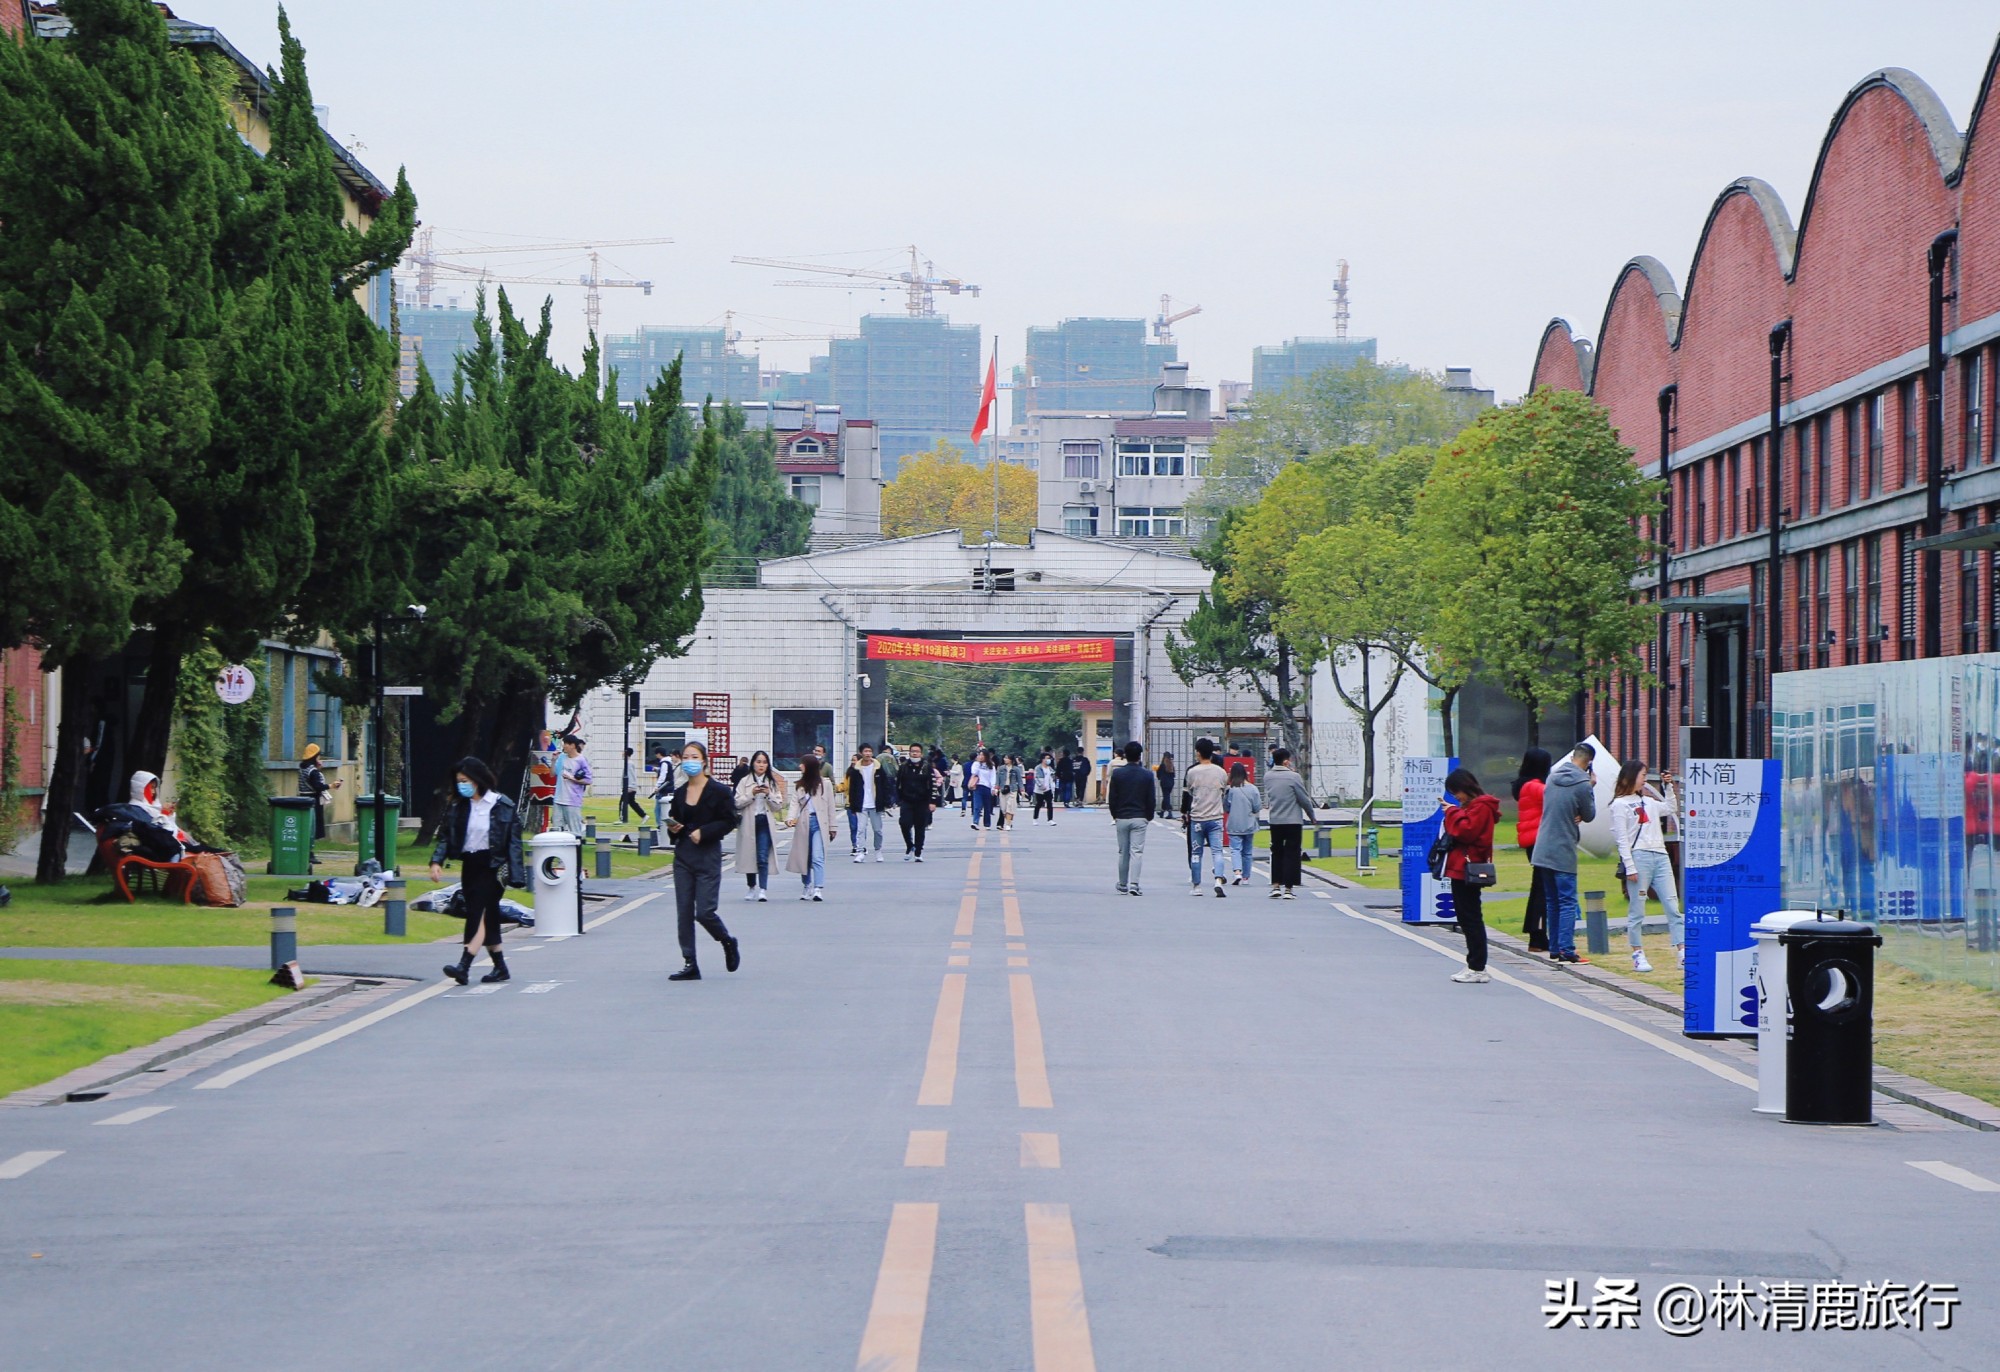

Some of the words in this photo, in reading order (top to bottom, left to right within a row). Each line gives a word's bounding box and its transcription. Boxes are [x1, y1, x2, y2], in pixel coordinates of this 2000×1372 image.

[877, 641, 966, 658] 2020年合柴119消防演习
[1404, 760, 1433, 773] 朴简
[1689, 763, 1735, 785] 朴简
[1404, 777, 1446, 785] 11.11艺术
[1690, 792, 1771, 806] 11.11艺术节
[1698, 810, 1751, 818] 成人艺术课程
[1689, 821, 1728, 829] 油画/水彩
[1689, 842, 1742, 850] 报半年送半年
